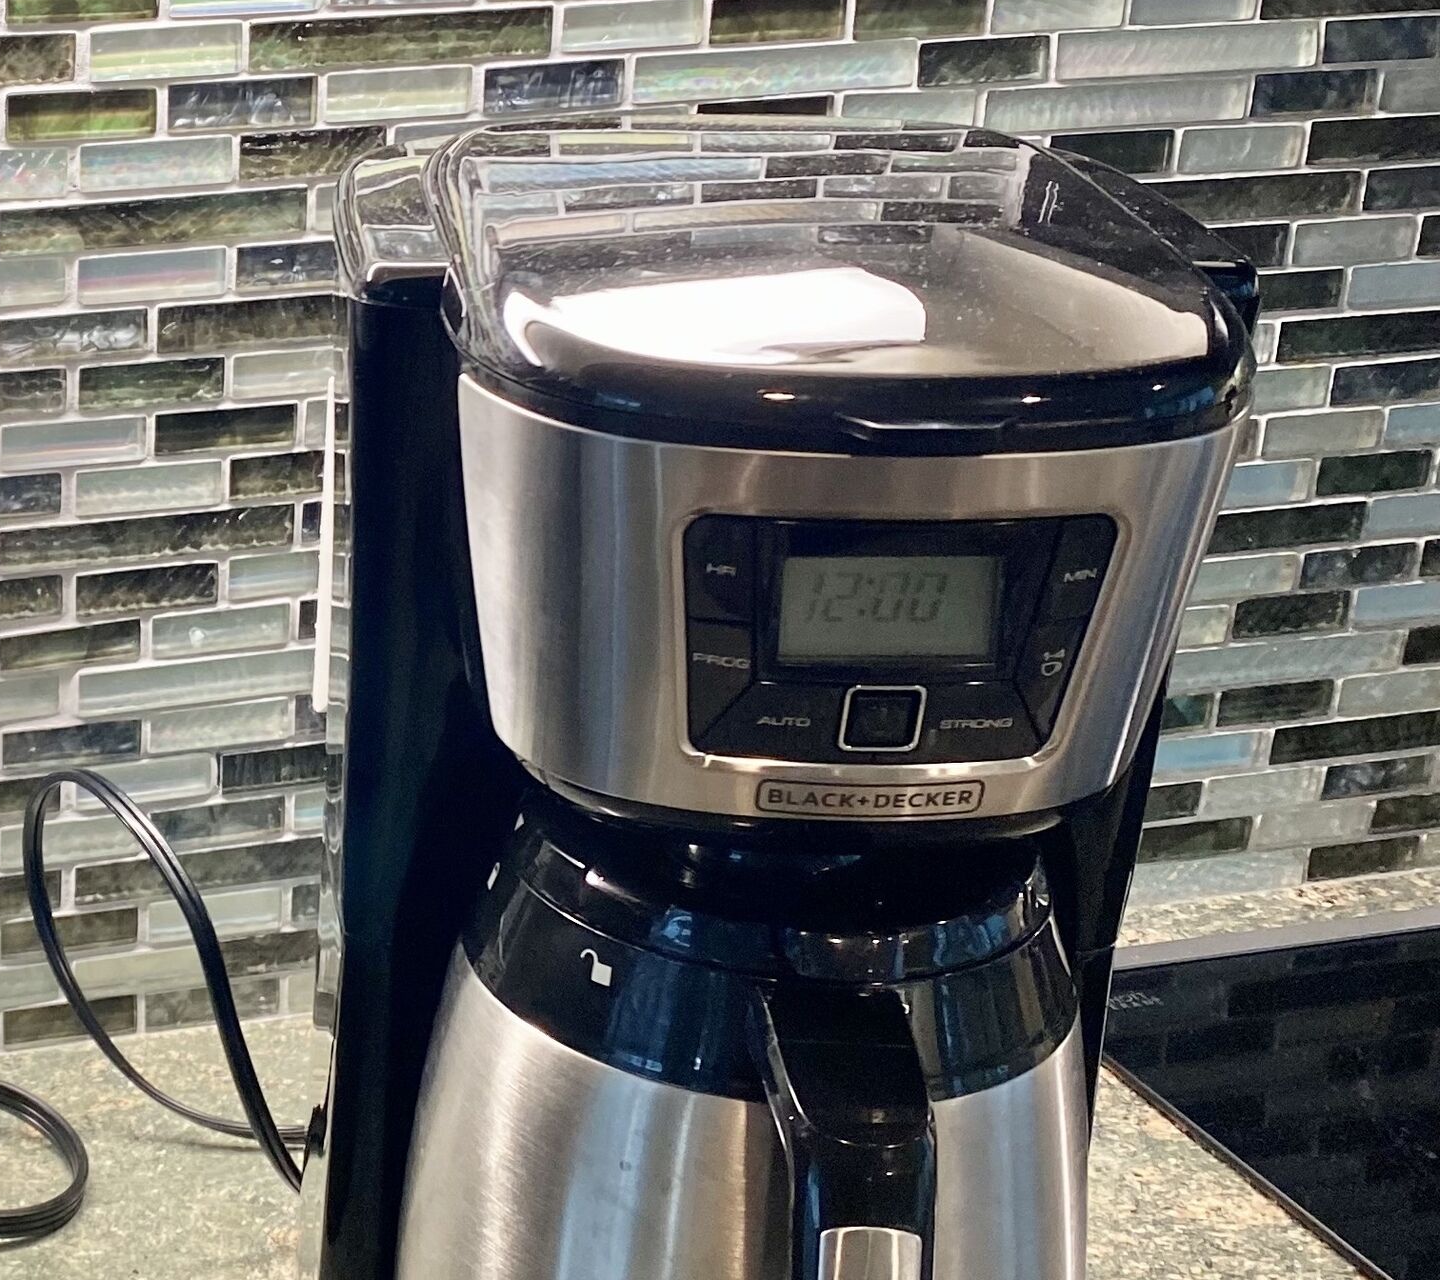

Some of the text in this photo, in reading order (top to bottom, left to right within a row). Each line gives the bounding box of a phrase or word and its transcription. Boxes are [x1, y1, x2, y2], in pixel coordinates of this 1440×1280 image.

[705, 561, 737, 578] HR
[1063, 566, 1099, 583] MIN
[805, 570, 948, 624] 12:00
[692, 651, 751, 670] PROG
[755, 715, 812, 729] AUTO
[939, 716, 1014, 730] STRONG
[766, 787, 973, 810] BLACK+DECKER
